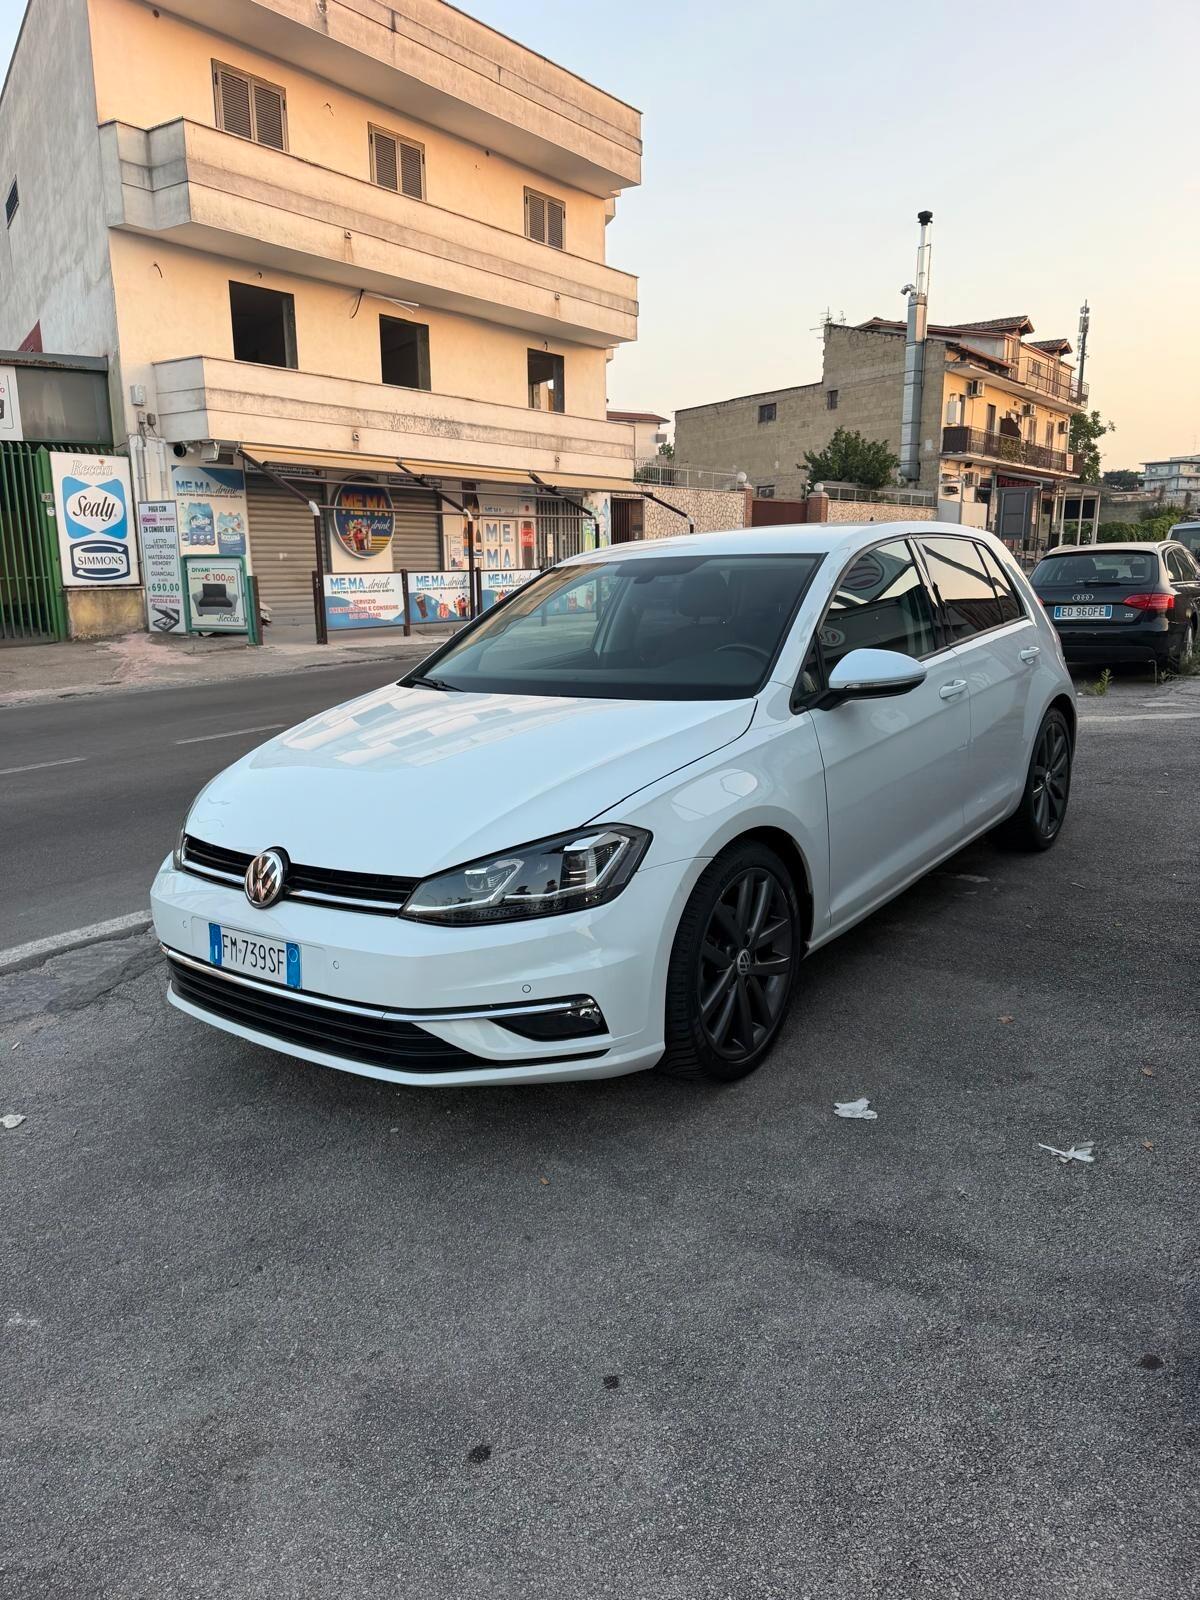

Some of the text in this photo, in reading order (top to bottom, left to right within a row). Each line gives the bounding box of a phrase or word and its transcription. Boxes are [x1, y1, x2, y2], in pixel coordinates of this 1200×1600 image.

[73, 496, 115, 522] Sealy
[165, 525, 175, 533] RATE
[78, 555, 124, 567] SIMMONS
[212, 573, 235, 582] 100,00
[1062, 607, 1073, 616] ED
